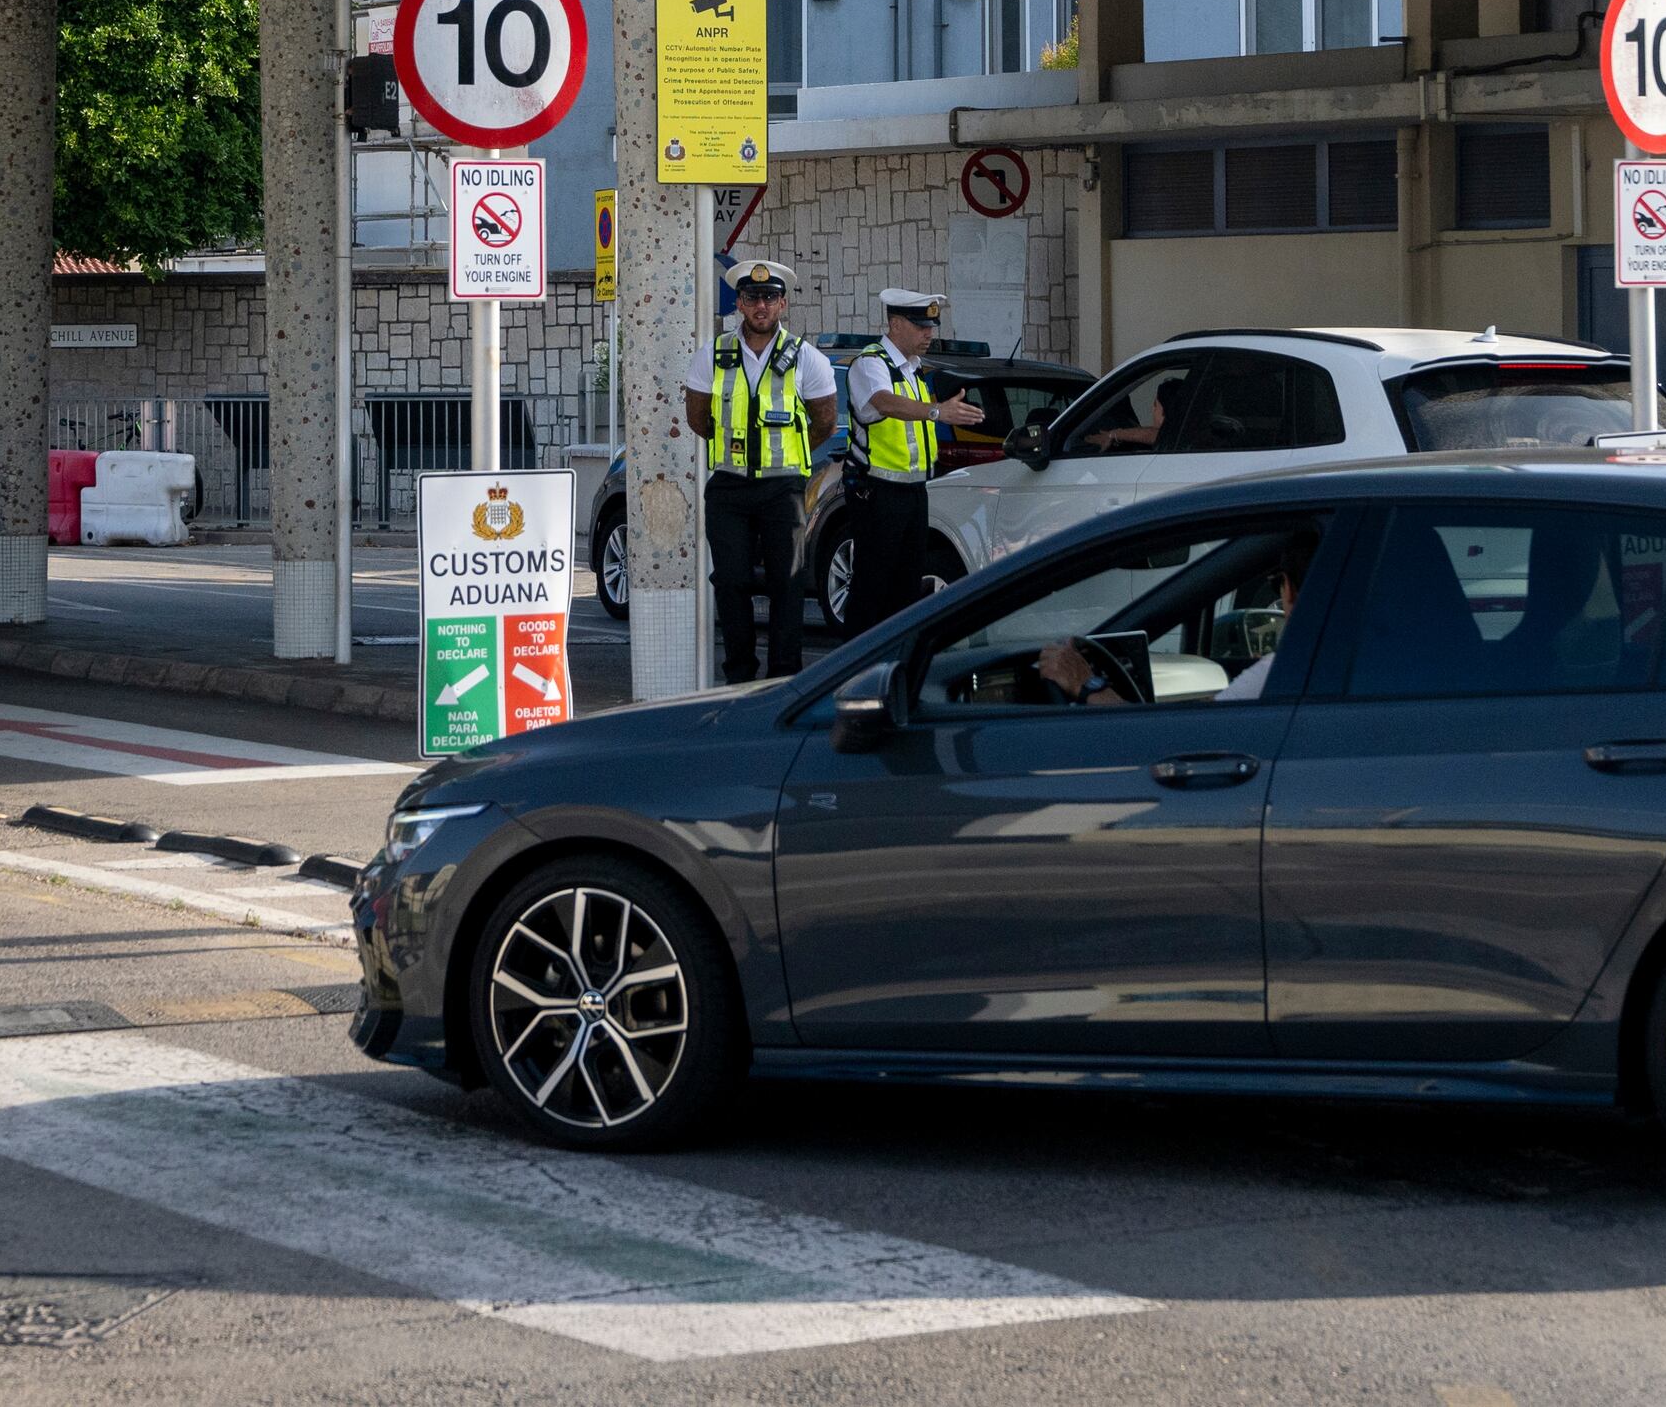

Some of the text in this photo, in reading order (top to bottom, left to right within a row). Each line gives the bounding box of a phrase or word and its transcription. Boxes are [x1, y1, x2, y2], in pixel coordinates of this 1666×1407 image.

[696, 27, 728, 38] ANPR
[385, 81, 397, 100] E2
[461, 170, 534, 186] NO IDLING
[1623, 170, 1641, 184] NO
[714, 190, 741, 206] VE
[714, 210, 736, 222] AY
[1635, 245, 1656, 255] TURN
[474, 254, 522, 265] TURN OFF
[1627, 260, 1650, 271] YOUR
[465, 271, 531, 282] YOUR ENGINE
[51, 330, 135, 341] CHILL AVENUE
[430, 549, 565, 577] CUSTOMS
[450, 582, 549, 606] ADUANA
[438, 624, 487, 636] NOTHING
[518, 620, 556, 632] GOODS
[455, 636, 470, 647] TO
[531, 633, 545, 643] TO
[437, 648, 488, 660] DECLARE
[513, 645, 560, 656] DECLARE
[448, 711, 478, 721] NADA
[515, 706, 561, 718] OBJETOS
[449, 723, 478, 733] PARA
